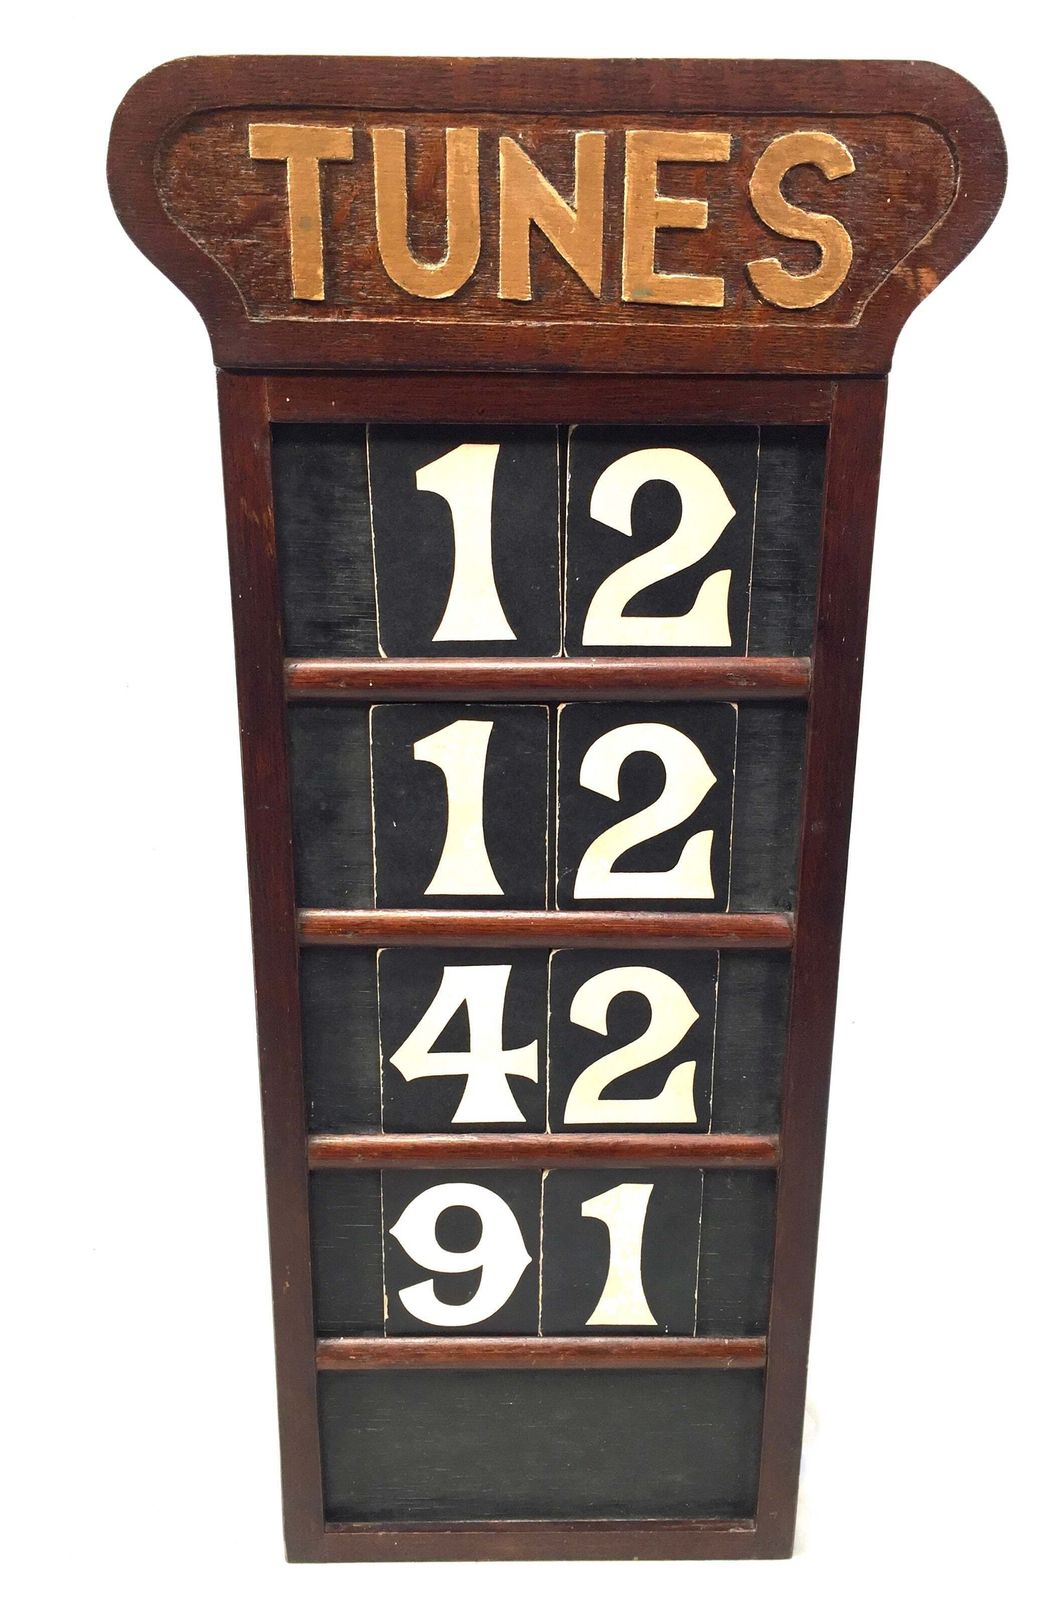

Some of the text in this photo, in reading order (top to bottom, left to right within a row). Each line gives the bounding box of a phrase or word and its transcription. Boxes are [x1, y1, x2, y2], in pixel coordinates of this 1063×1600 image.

[248, 122, 856, 309] TUNES
[415, 443, 737, 647] 12
[413, 719, 718, 900] 12
[389, 964, 700, 1126] 42
[388, 1182, 658, 1327] 91
